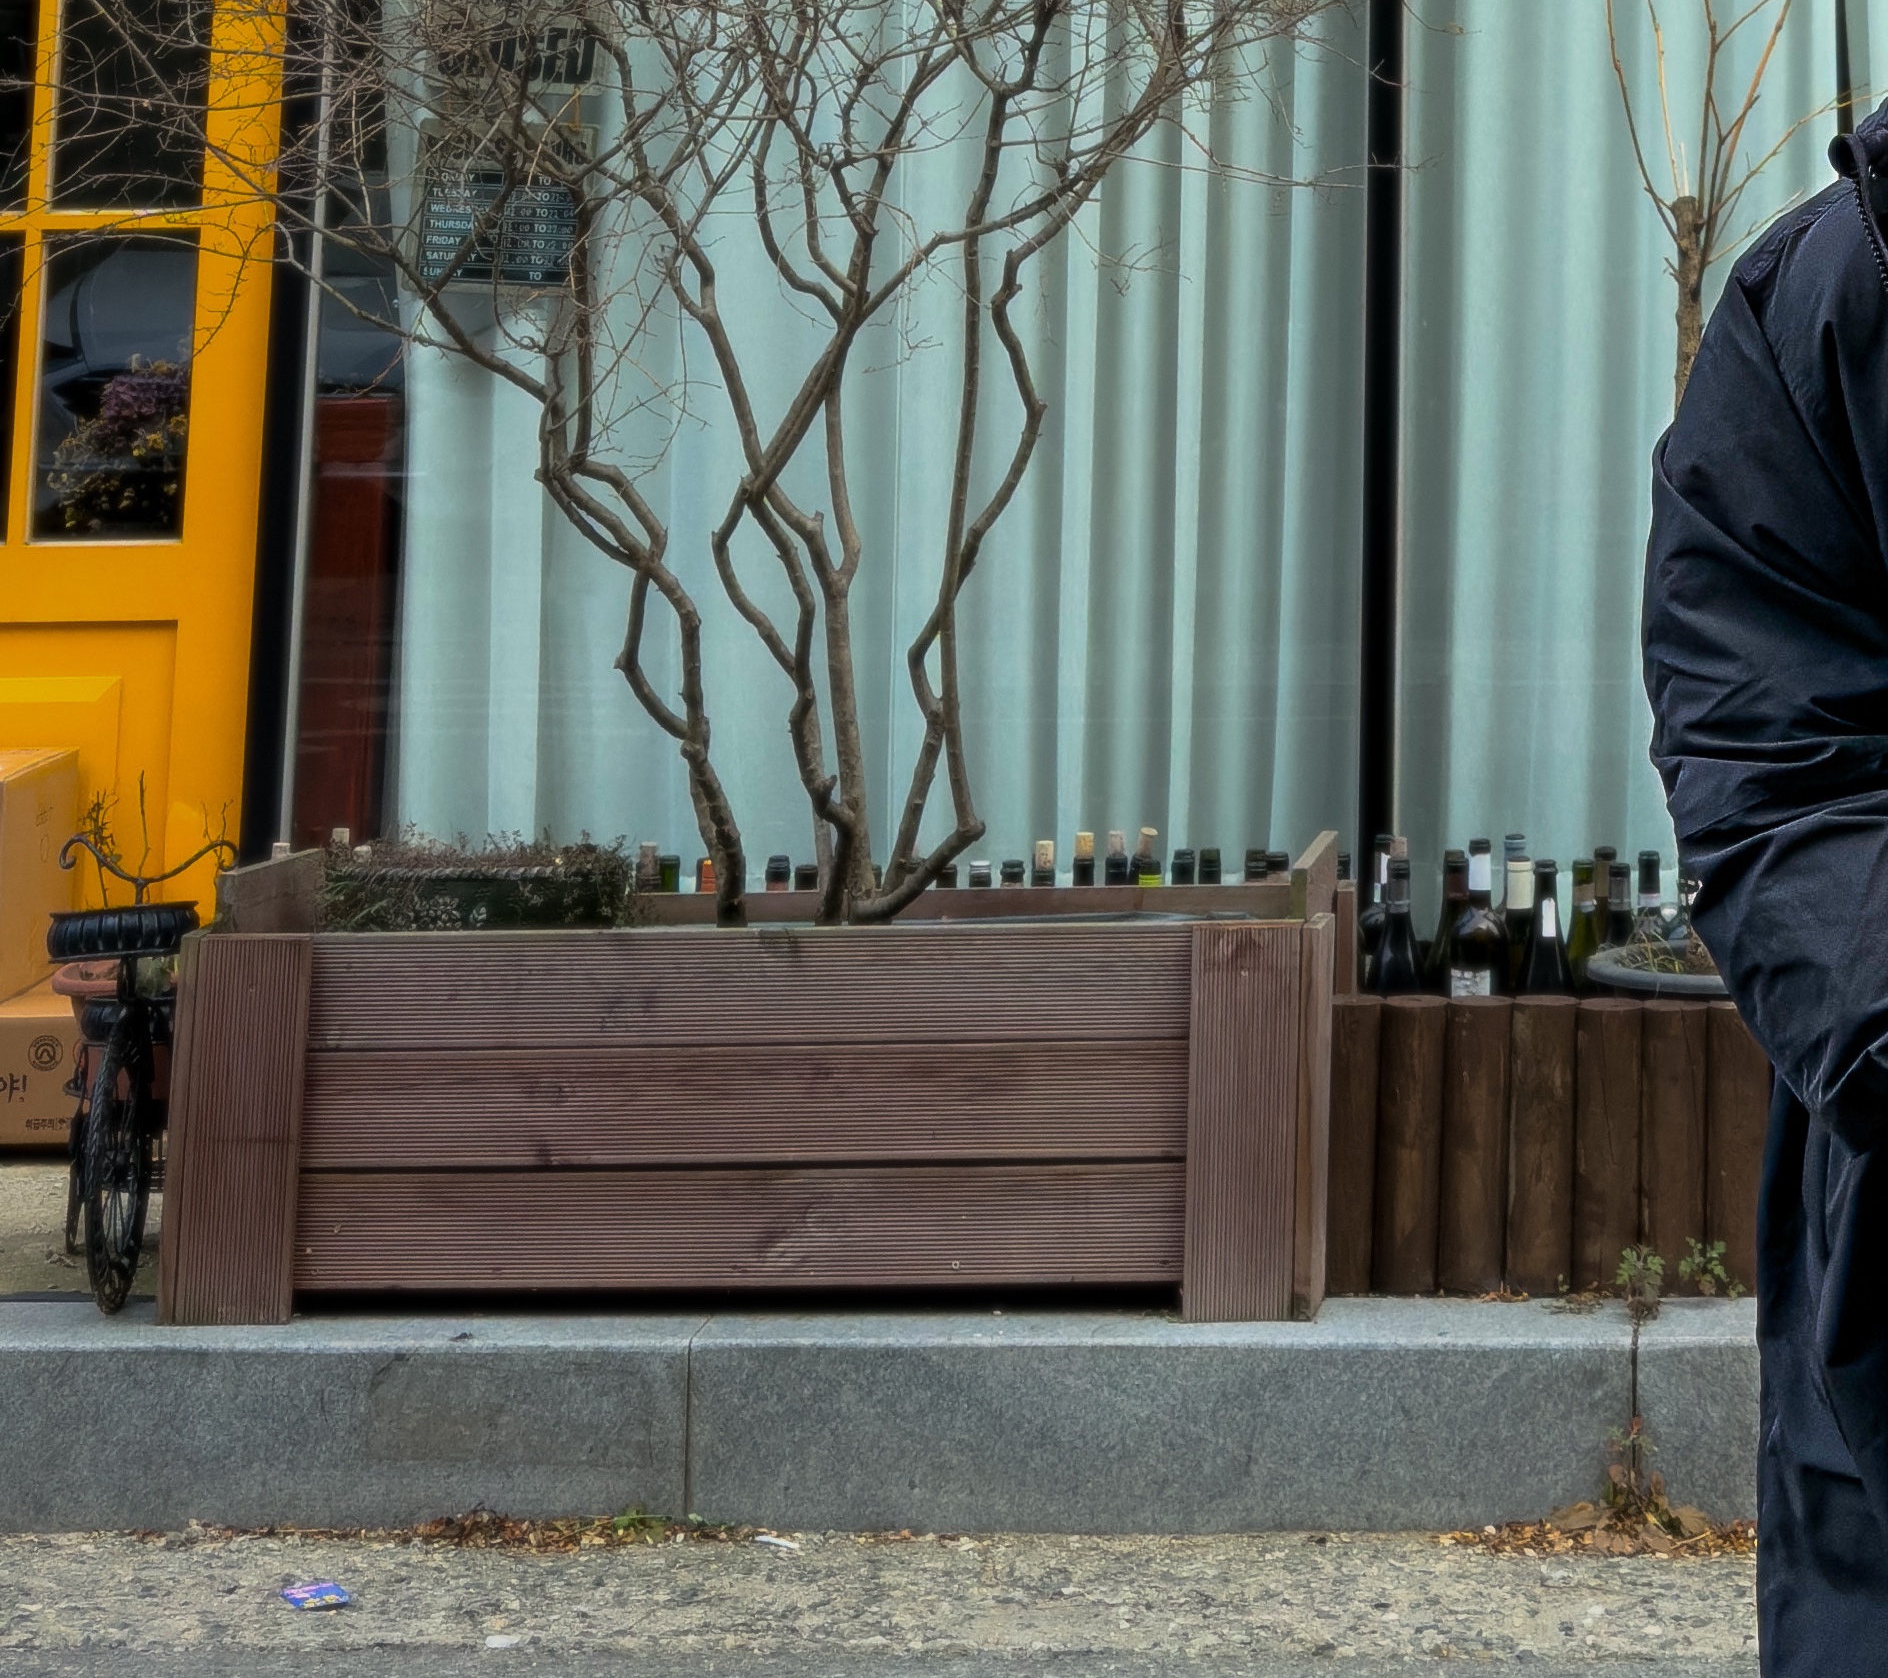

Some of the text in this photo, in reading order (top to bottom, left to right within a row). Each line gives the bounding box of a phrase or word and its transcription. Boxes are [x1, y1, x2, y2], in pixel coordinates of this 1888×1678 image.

[538, 176, 552, 186] TO
[535, 208, 548, 218] TO
[533, 223, 547, 233] TO
[425, 235, 462, 245] FRIDAY
[532, 239, 545, 249] TO
[530, 255, 544, 265] TO
[529, 271, 542, 281] TO
